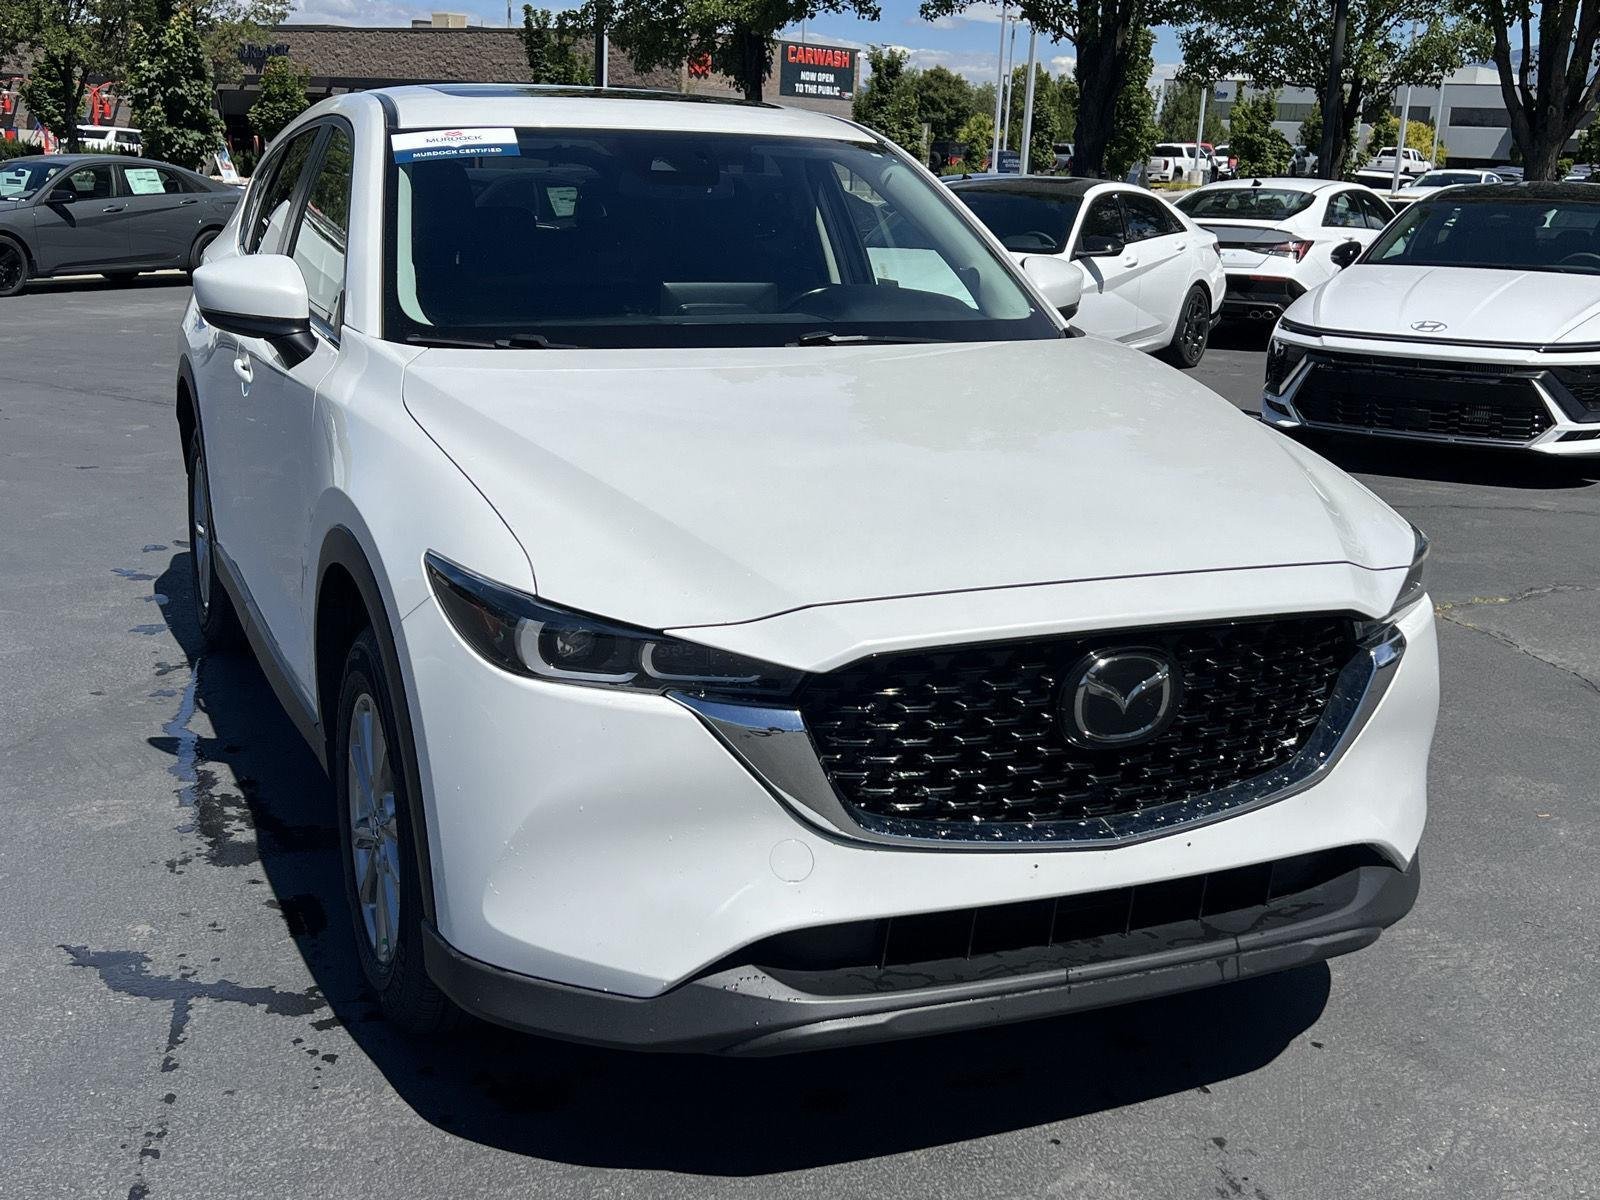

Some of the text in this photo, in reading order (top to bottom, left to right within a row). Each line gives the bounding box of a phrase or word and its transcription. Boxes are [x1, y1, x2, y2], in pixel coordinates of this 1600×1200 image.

[787, 45, 850, 68] CARWASH
[800, 71, 834, 83] NOW OPEN
[795, 83, 803, 92] TO
[804, 84, 817, 94] THE
[817, 85, 840, 96] PUBLIC
[425, 135, 483, 144] MURDOCK
[412, 150, 458, 158] MURDOCK
